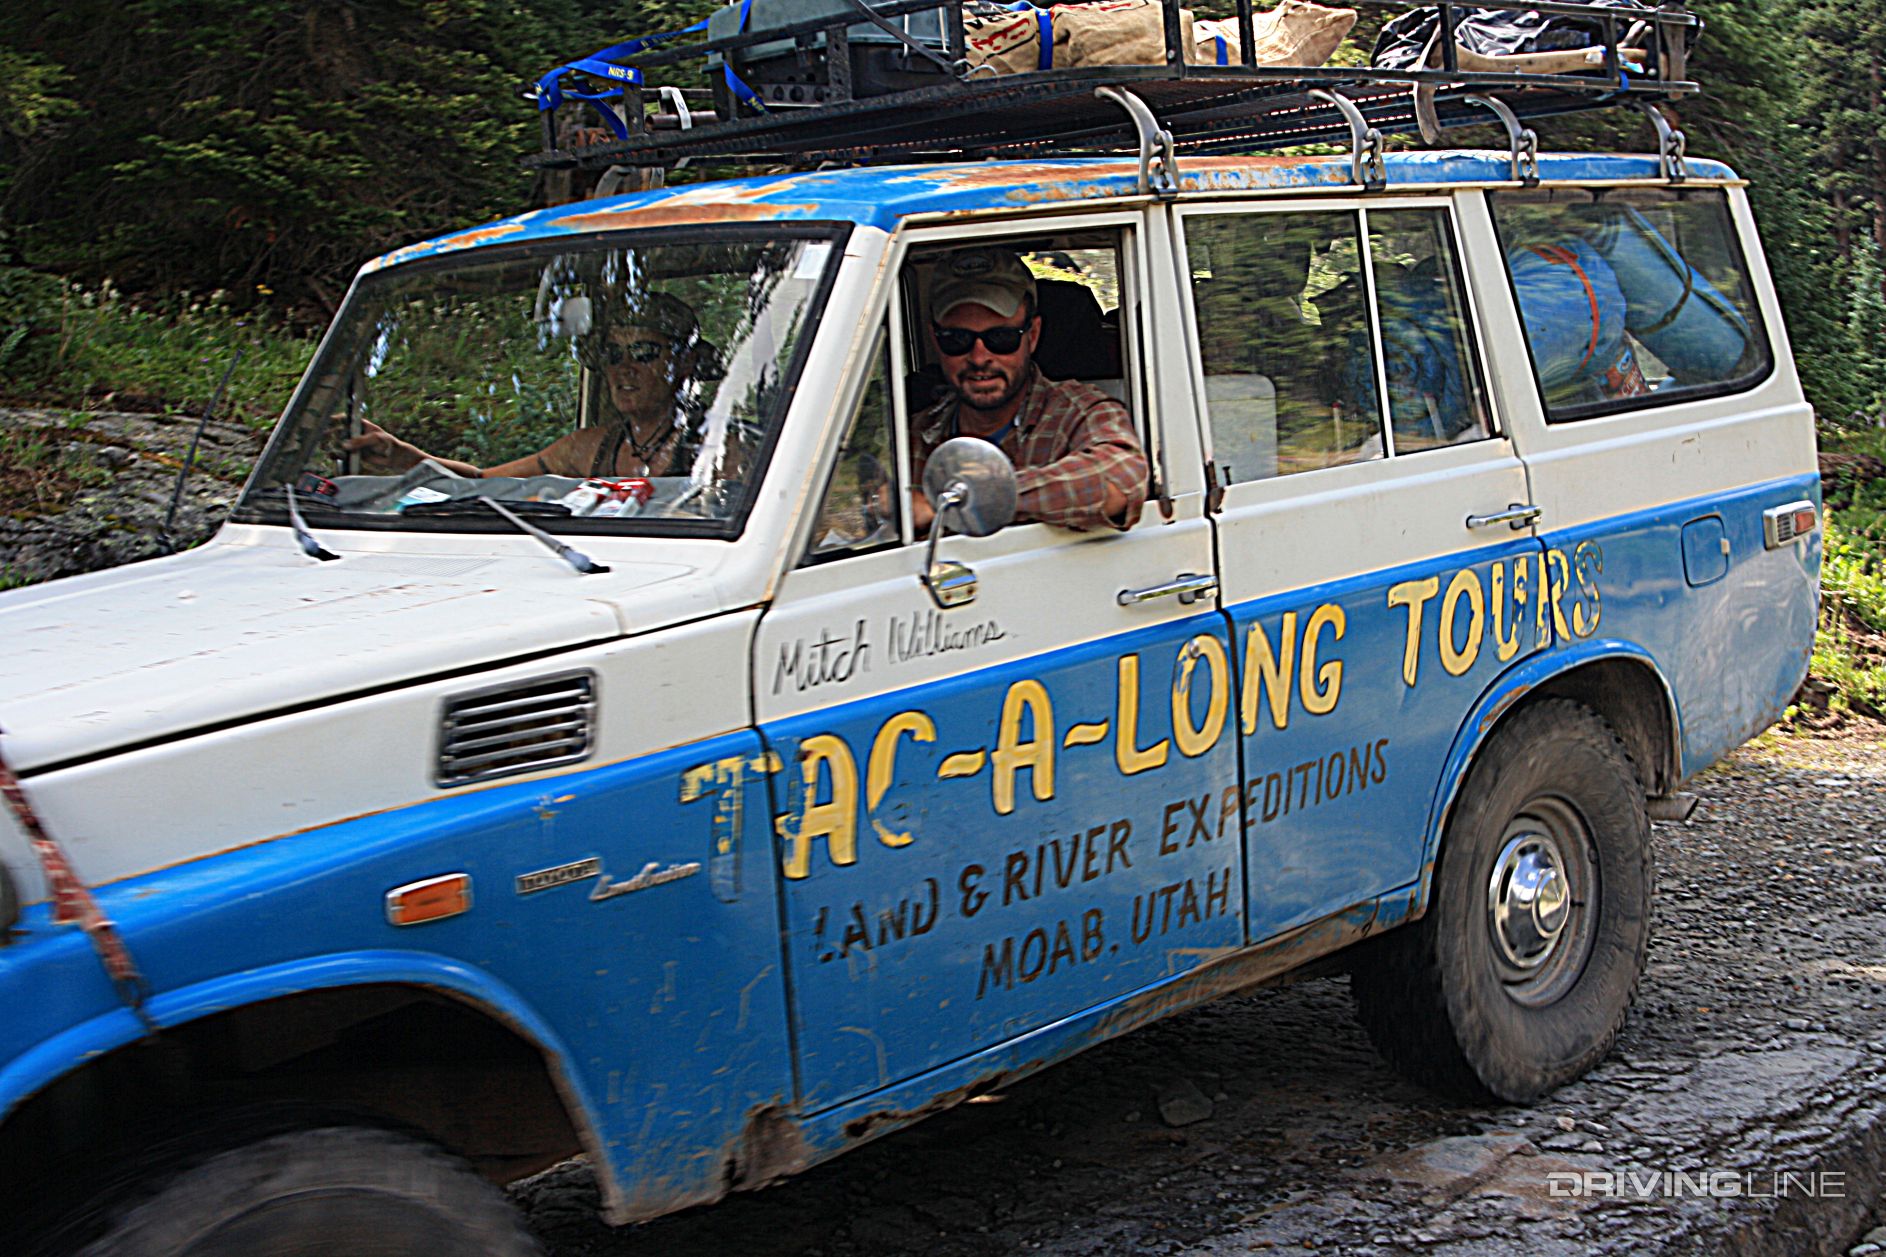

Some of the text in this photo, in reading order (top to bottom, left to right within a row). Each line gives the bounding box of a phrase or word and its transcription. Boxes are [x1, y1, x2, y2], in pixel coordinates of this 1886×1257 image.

[772, 608, 1007, 695] Mitch Williams
[1387, 539, 1604, 687] TOURS
[813, 738, 1390, 964] LAND & RIVER EXPEDITIONS
